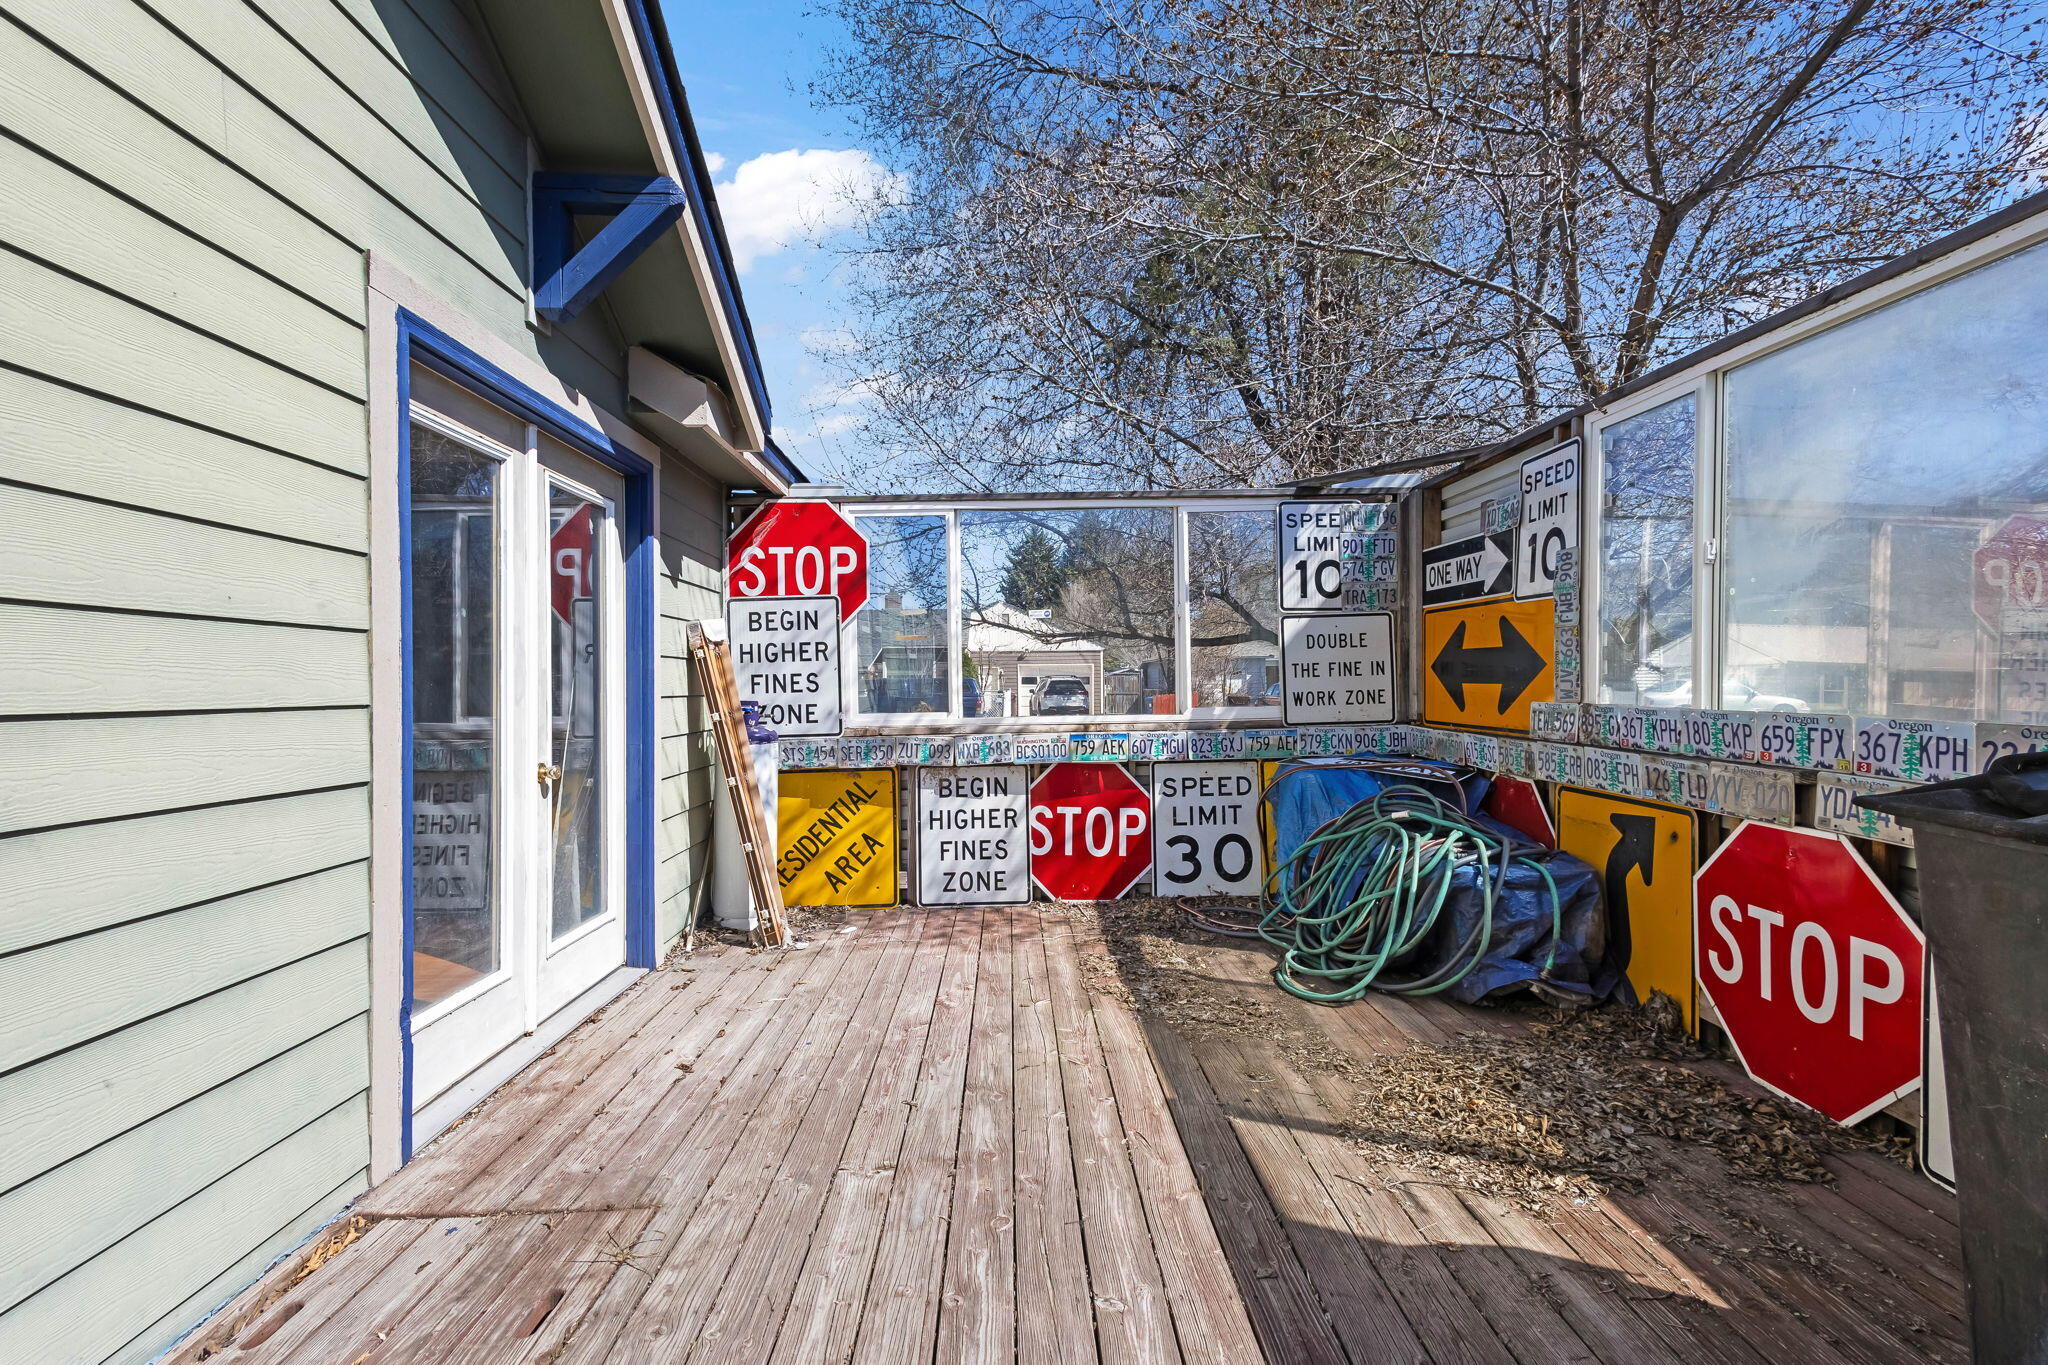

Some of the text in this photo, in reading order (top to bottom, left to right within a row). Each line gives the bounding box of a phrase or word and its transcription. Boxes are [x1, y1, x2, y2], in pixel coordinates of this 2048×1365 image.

[1525, 458, 1575, 494] SPEED
[1529, 492, 1568, 524] LIMIT
[1286, 513, 1340, 528] SPEE
[1294, 536, 1340, 552] LIMI
[1343, 539, 1396, 554] 901 FTD
[1528, 527, 1566, 583] 10
[738, 545, 858, 597] STOP
[1343, 560, 1395, 577] 574 FGV
[1429, 555, 1482, 588] ONE WAY
[1559, 552, 1572, 582] 806
[1295, 559, 1342, 599] 10
[1345, 589, 1396, 604] TRA 173
[748, 610, 819, 632] BEGIN
[1306, 633, 1368, 649] DOUBLE
[739, 642, 829, 663] HIGHER
[1292, 661, 1385, 678] THE FINE IN
[750, 672, 820, 694] FINES
[1293, 690, 1386, 707] WORK ZONE
[758, 703, 819, 725] ZONE
[1556, 712, 1576, 733] 569
[1634, 707, 1657, 717] Oregon
[1701, 711, 1728, 721] Oregon
[1785, 714, 1819, 726] Oregon
[1622, 716, 1677, 743] 367 KPH
[1685, 720, 1752, 750] 180 CKP
[1889, 720, 1933, 733] Oregon
[2021, 727, 2048, 740] Ore
[898, 742, 951, 759] ZUT 093
[988, 741, 1011, 756] 683
[1073, 740, 1125, 756] 759 AEK
[1131, 739, 1185, 754] 607 MGU
[1191, 738, 1243, 753] 823 GXJ
[1249, 736, 1270, 751] 759
[1300, 734, 1353, 750] 579 CKN
[1355, 733, 1378, 748] 906
[1386, 732, 1407, 747] JBH
[1761, 725, 1846, 759] 659 FPX
[782, 745, 836, 763] STS 454
[841, 744, 893, 761] SER 350
[1499, 746, 1514, 766] 585
[1858, 730, 1901, 764] 367
[1919, 735, 1968, 772] KPH
[1538, 751, 1581, 777] 585 ERB
[1586, 757, 1640, 788] 083 EPH
[1661, 759, 1686, 770] Oregon
[939, 777, 1008, 798] BEGIN
[1162, 776, 1251, 798] SPEED
[1645, 766, 1707, 800] 126 FLD
[929, 808, 1018, 830] HIGHER
[1172, 805, 1243, 826] LIMIT
[1030, 805, 1147, 857] STOP
[940, 839, 1008, 861] FINES
[1164, 833, 1254, 884] 30
[824, 832, 885, 894] AREA
[942, 871, 1007, 892] ZONE
[1708, 894, 1905, 1042] STOP
